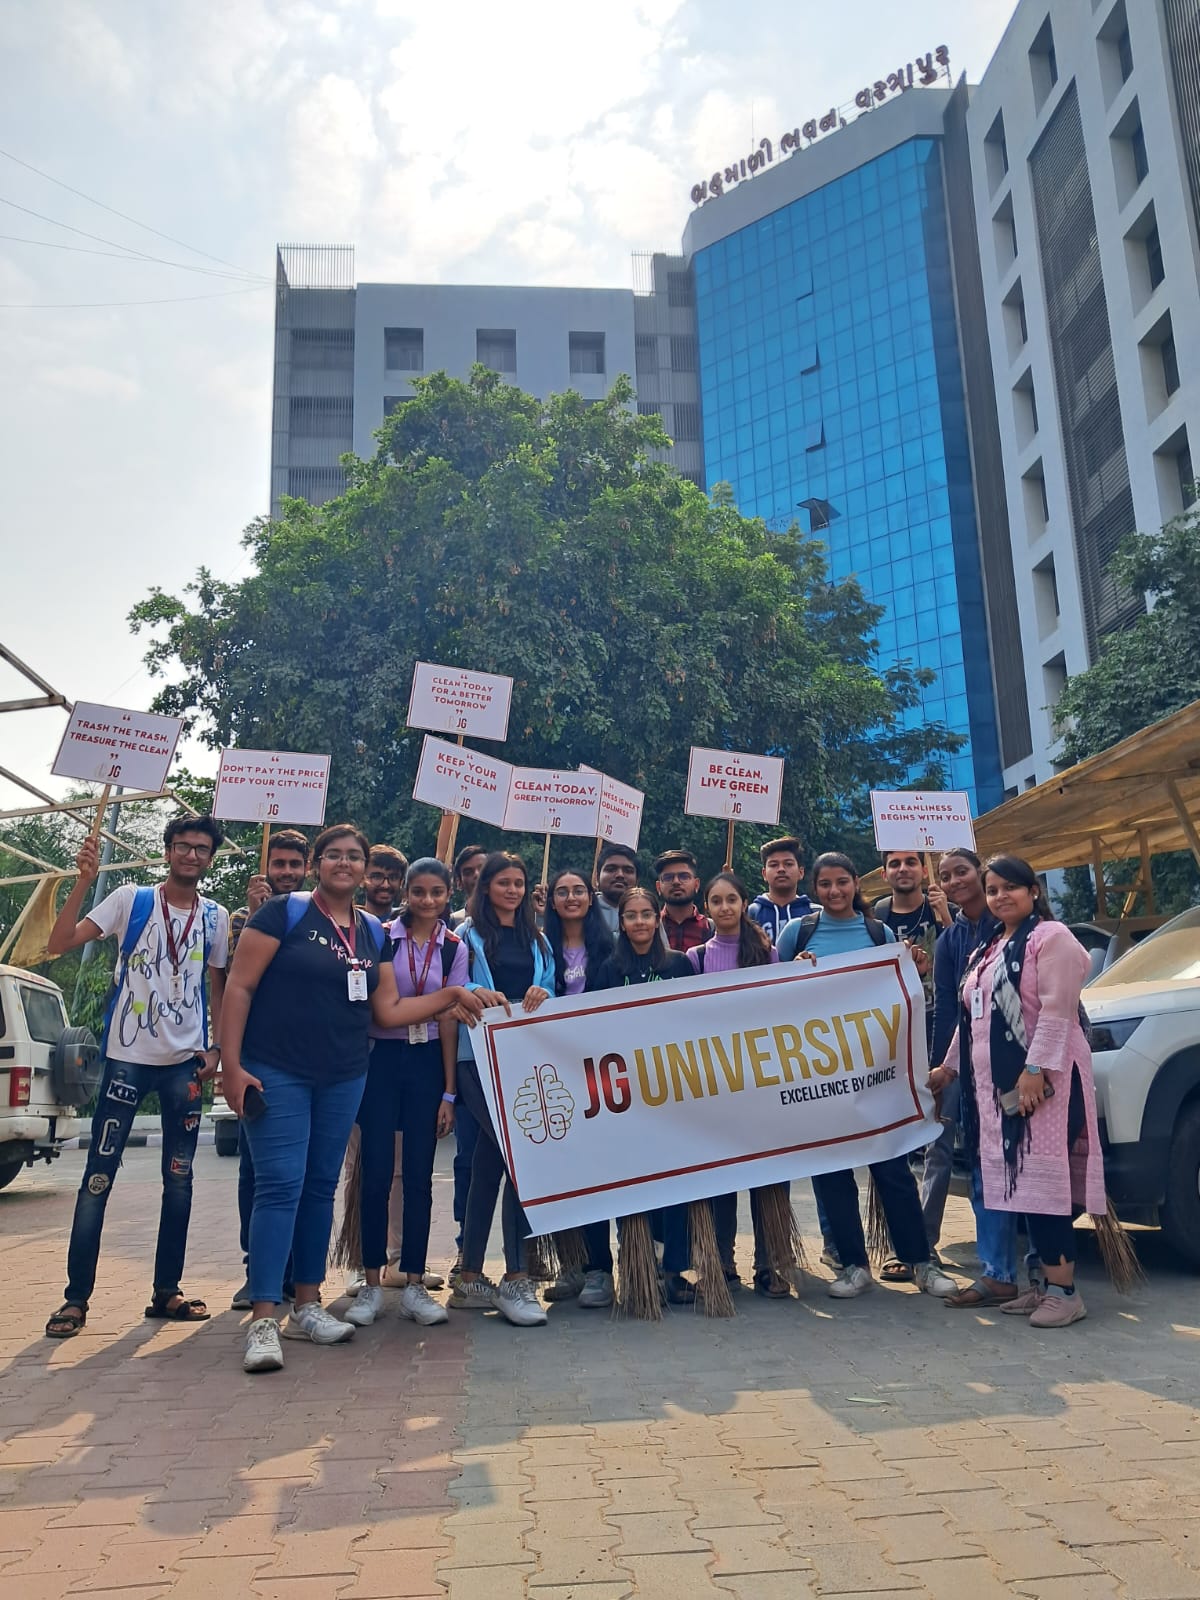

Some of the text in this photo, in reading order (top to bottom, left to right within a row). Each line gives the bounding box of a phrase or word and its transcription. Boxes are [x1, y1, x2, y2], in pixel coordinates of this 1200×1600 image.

[432, 678, 494, 692] CLEAN TODAY
[432, 686, 448, 694] FOR
[460, 691, 492, 701] BETTER
[434, 696, 486, 710] TOMORROW
[456, 718, 467, 729] JG
[78, 720, 168, 743] TRASH THE TRASH,
[70, 732, 169, 756] TREASURE THE CLEAN
[108, 765, 122, 778] JG
[223, 764, 253, 773] DON'T
[278, 768, 296, 776] THE
[298, 770, 325, 778] PRICE
[438, 752, 497, 779] KEEP YOUR
[709, 764, 762, 780] BE CLEAN,
[222, 776, 246, 784] KEEP
[249, 778, 275, 786] YOUR
[436, 765, 497, 792] CITY CLEAN
[514, 781, 551, 791] CLEAN
[701, 777, 768, 794] LIVE GREEN
[461, 797, 471, 809] JG
[514, 794, 595, 806] GREEN TOMORROW
[624, 801, 640, 812] NEXT
[268, 804, 279, 815] JG
[602, 802, 629, 818] ODLINESS
[732, 803, 742, 814] JG
[889, 804, 953, 812] CLEANLINESS
[551, 817, 560, 828] JG
[605, 824, 613, 835] JG
[925, 836, 934, 846] JG
[583, 1004, 901, 1119] JG UNIVERSITY
[780, 1066, 896, 1106] EXCELLENCE BY CHOICE
